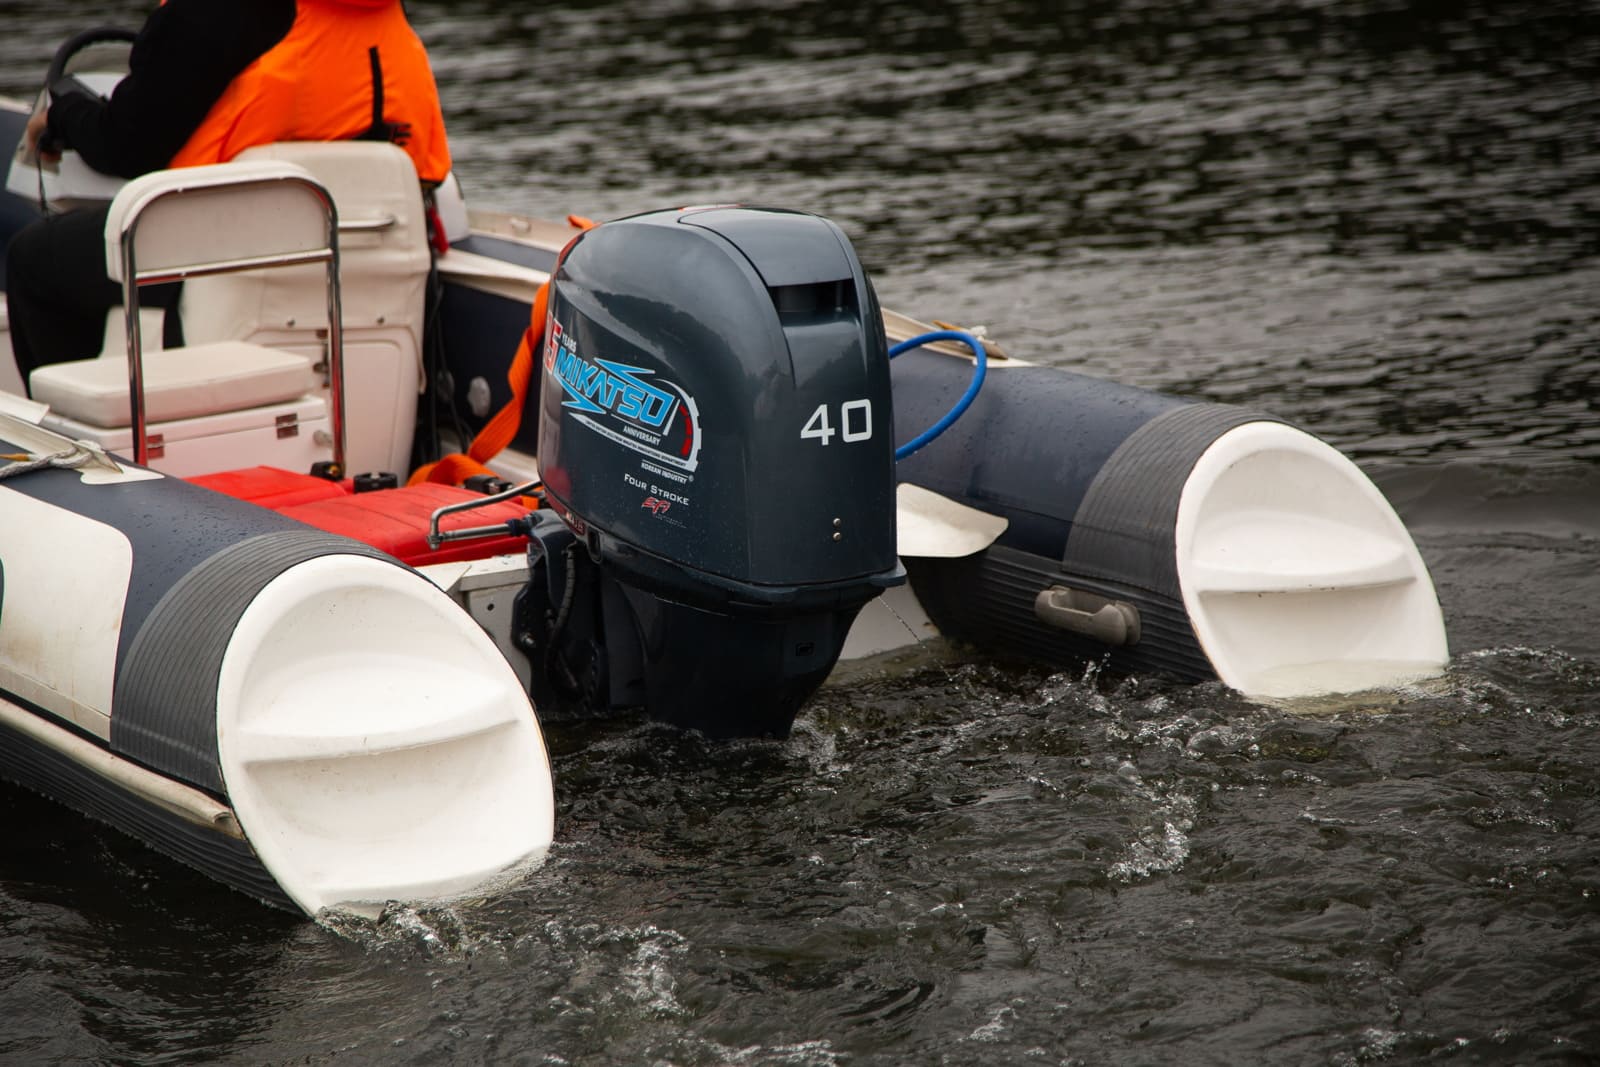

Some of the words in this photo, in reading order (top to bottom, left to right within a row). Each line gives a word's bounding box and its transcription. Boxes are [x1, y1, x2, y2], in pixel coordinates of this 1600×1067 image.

[623, 425, 661, 446] ANNIVERSARY
[800, 399, 872, 445] 40
[640, 462, 662, 475] KOREAN
[661, 470, 688, 484] INDUSTRY
[624, 473, 648, 490] FOUR
[650, 485, 690, 506] STROKE
